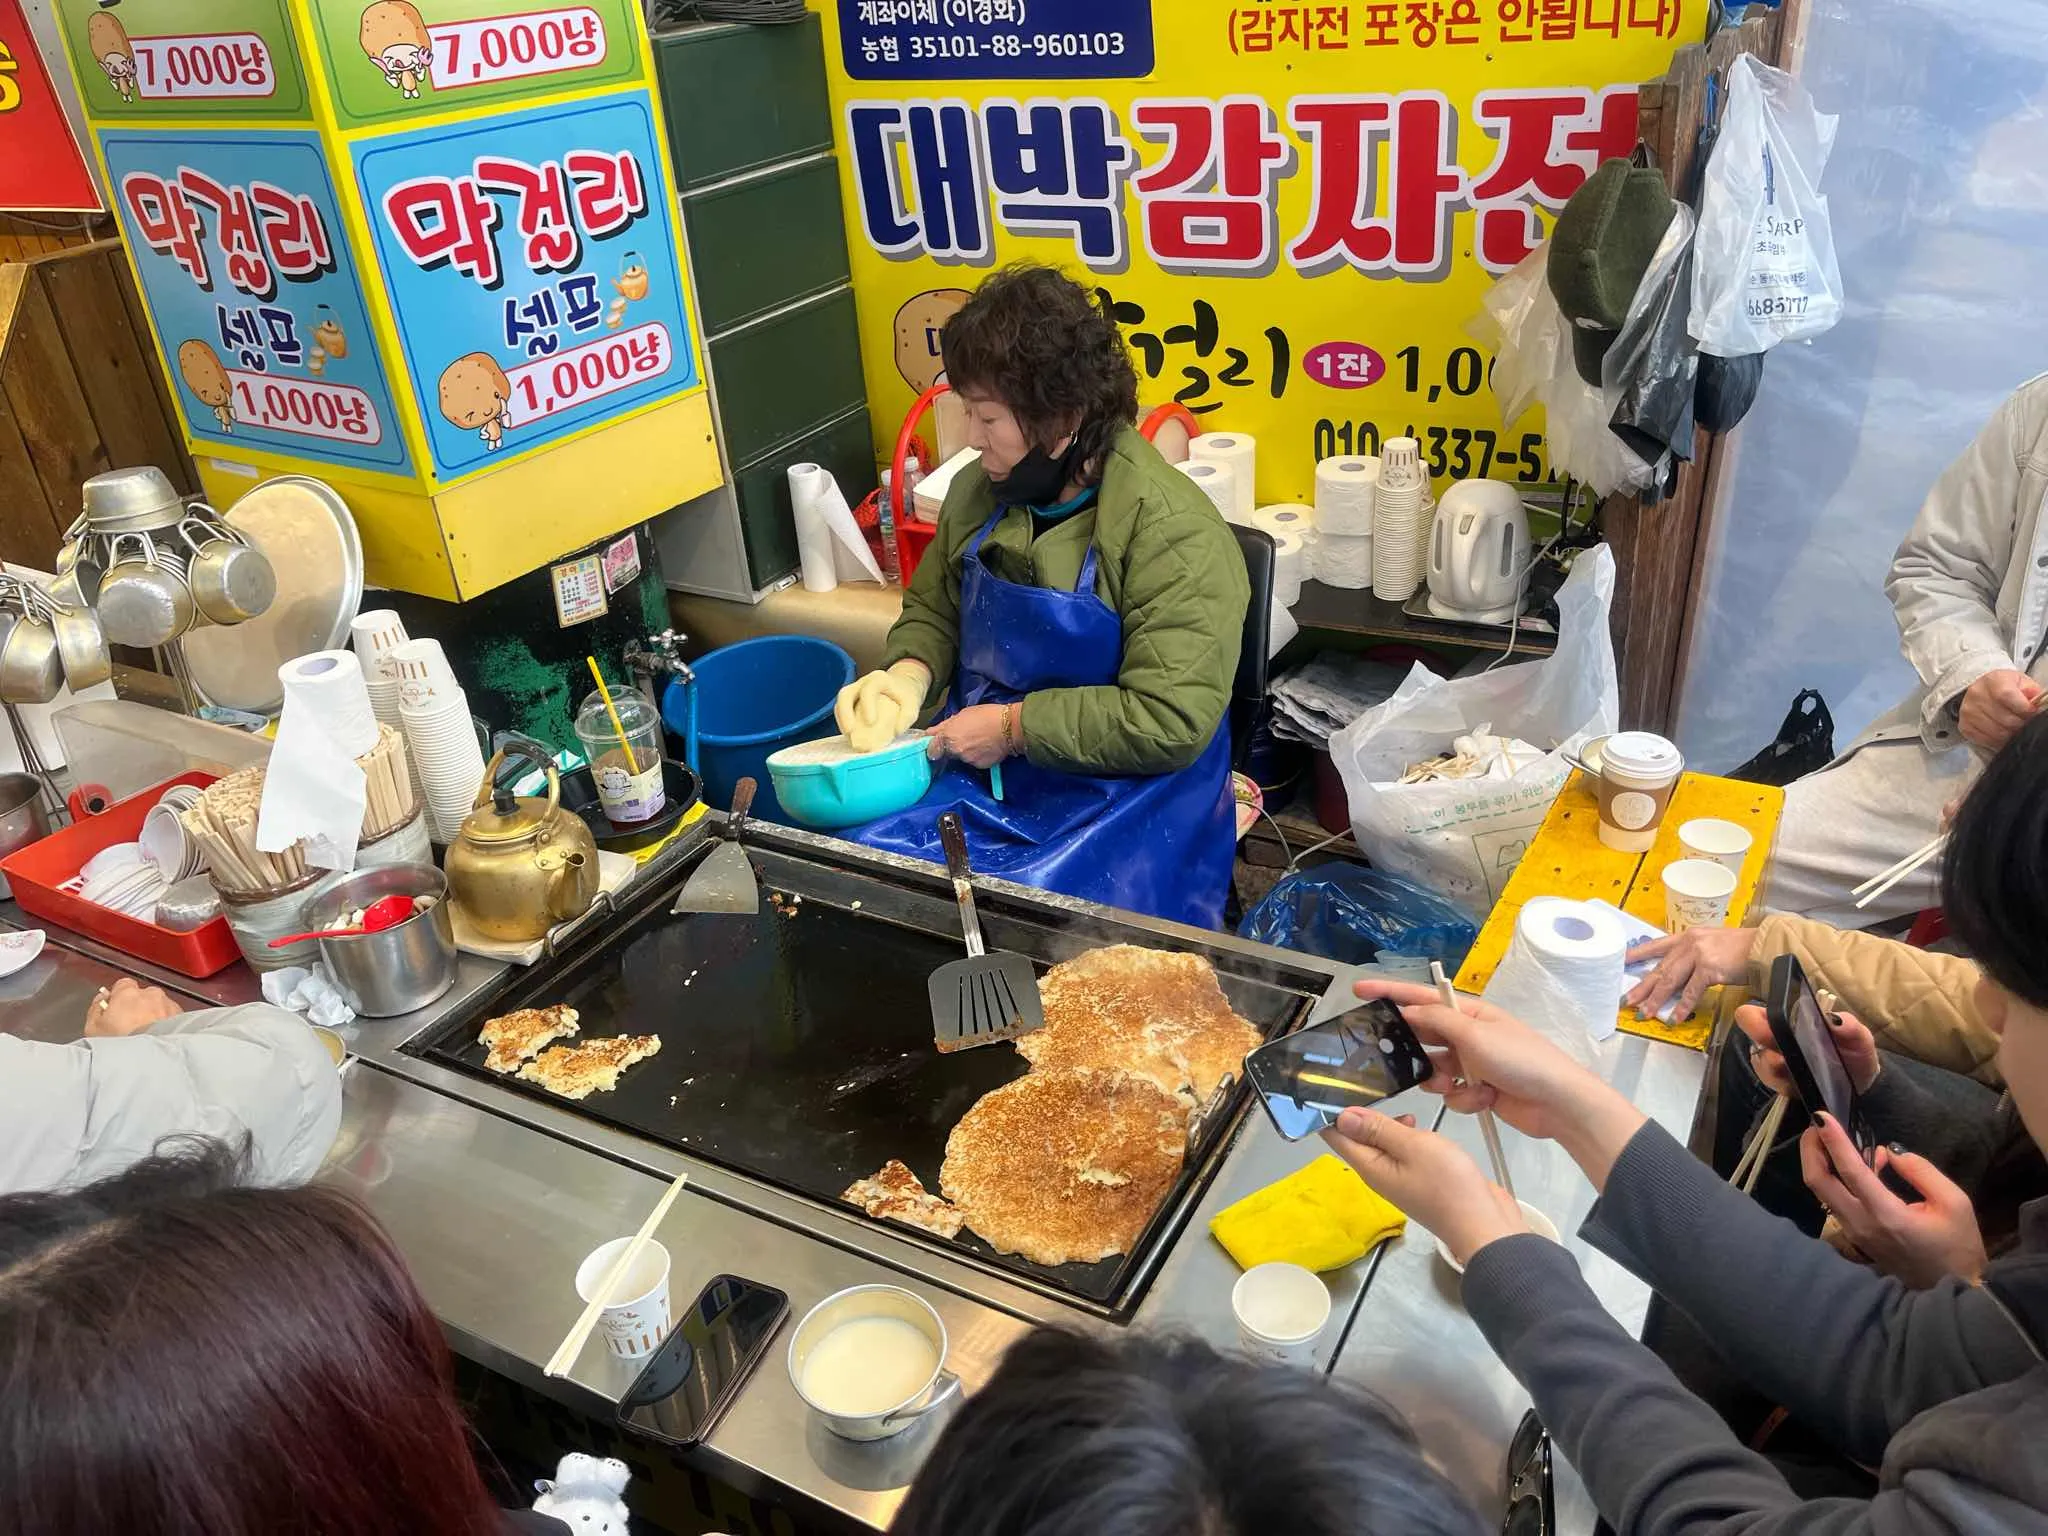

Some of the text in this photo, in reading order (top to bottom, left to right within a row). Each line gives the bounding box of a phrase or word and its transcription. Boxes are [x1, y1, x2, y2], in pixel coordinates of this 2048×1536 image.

[858, 0, 939, 25] 계좌이체
[1228, 0, 1682, 55] (감자전 포장은 안됩니다)
[136, 43, 267, 93] 7,000냥
[434, 16, 598, 79] 7,000냥
[861, 32, 1125, 62] 농협 35101-88-960103
[123, 168, 329, 293] 막걸리
[385, 151, 643, 283] 막걸리
[216, 304, 302, 372] 셀프
[504, 273, 602, 357] 셀프
[515, 330, 662, 413] 1,000냥
[1095, 288, 1496, 415] 걸리 1잔 1,0
[236, 380, 369, 435] 1,000냥
